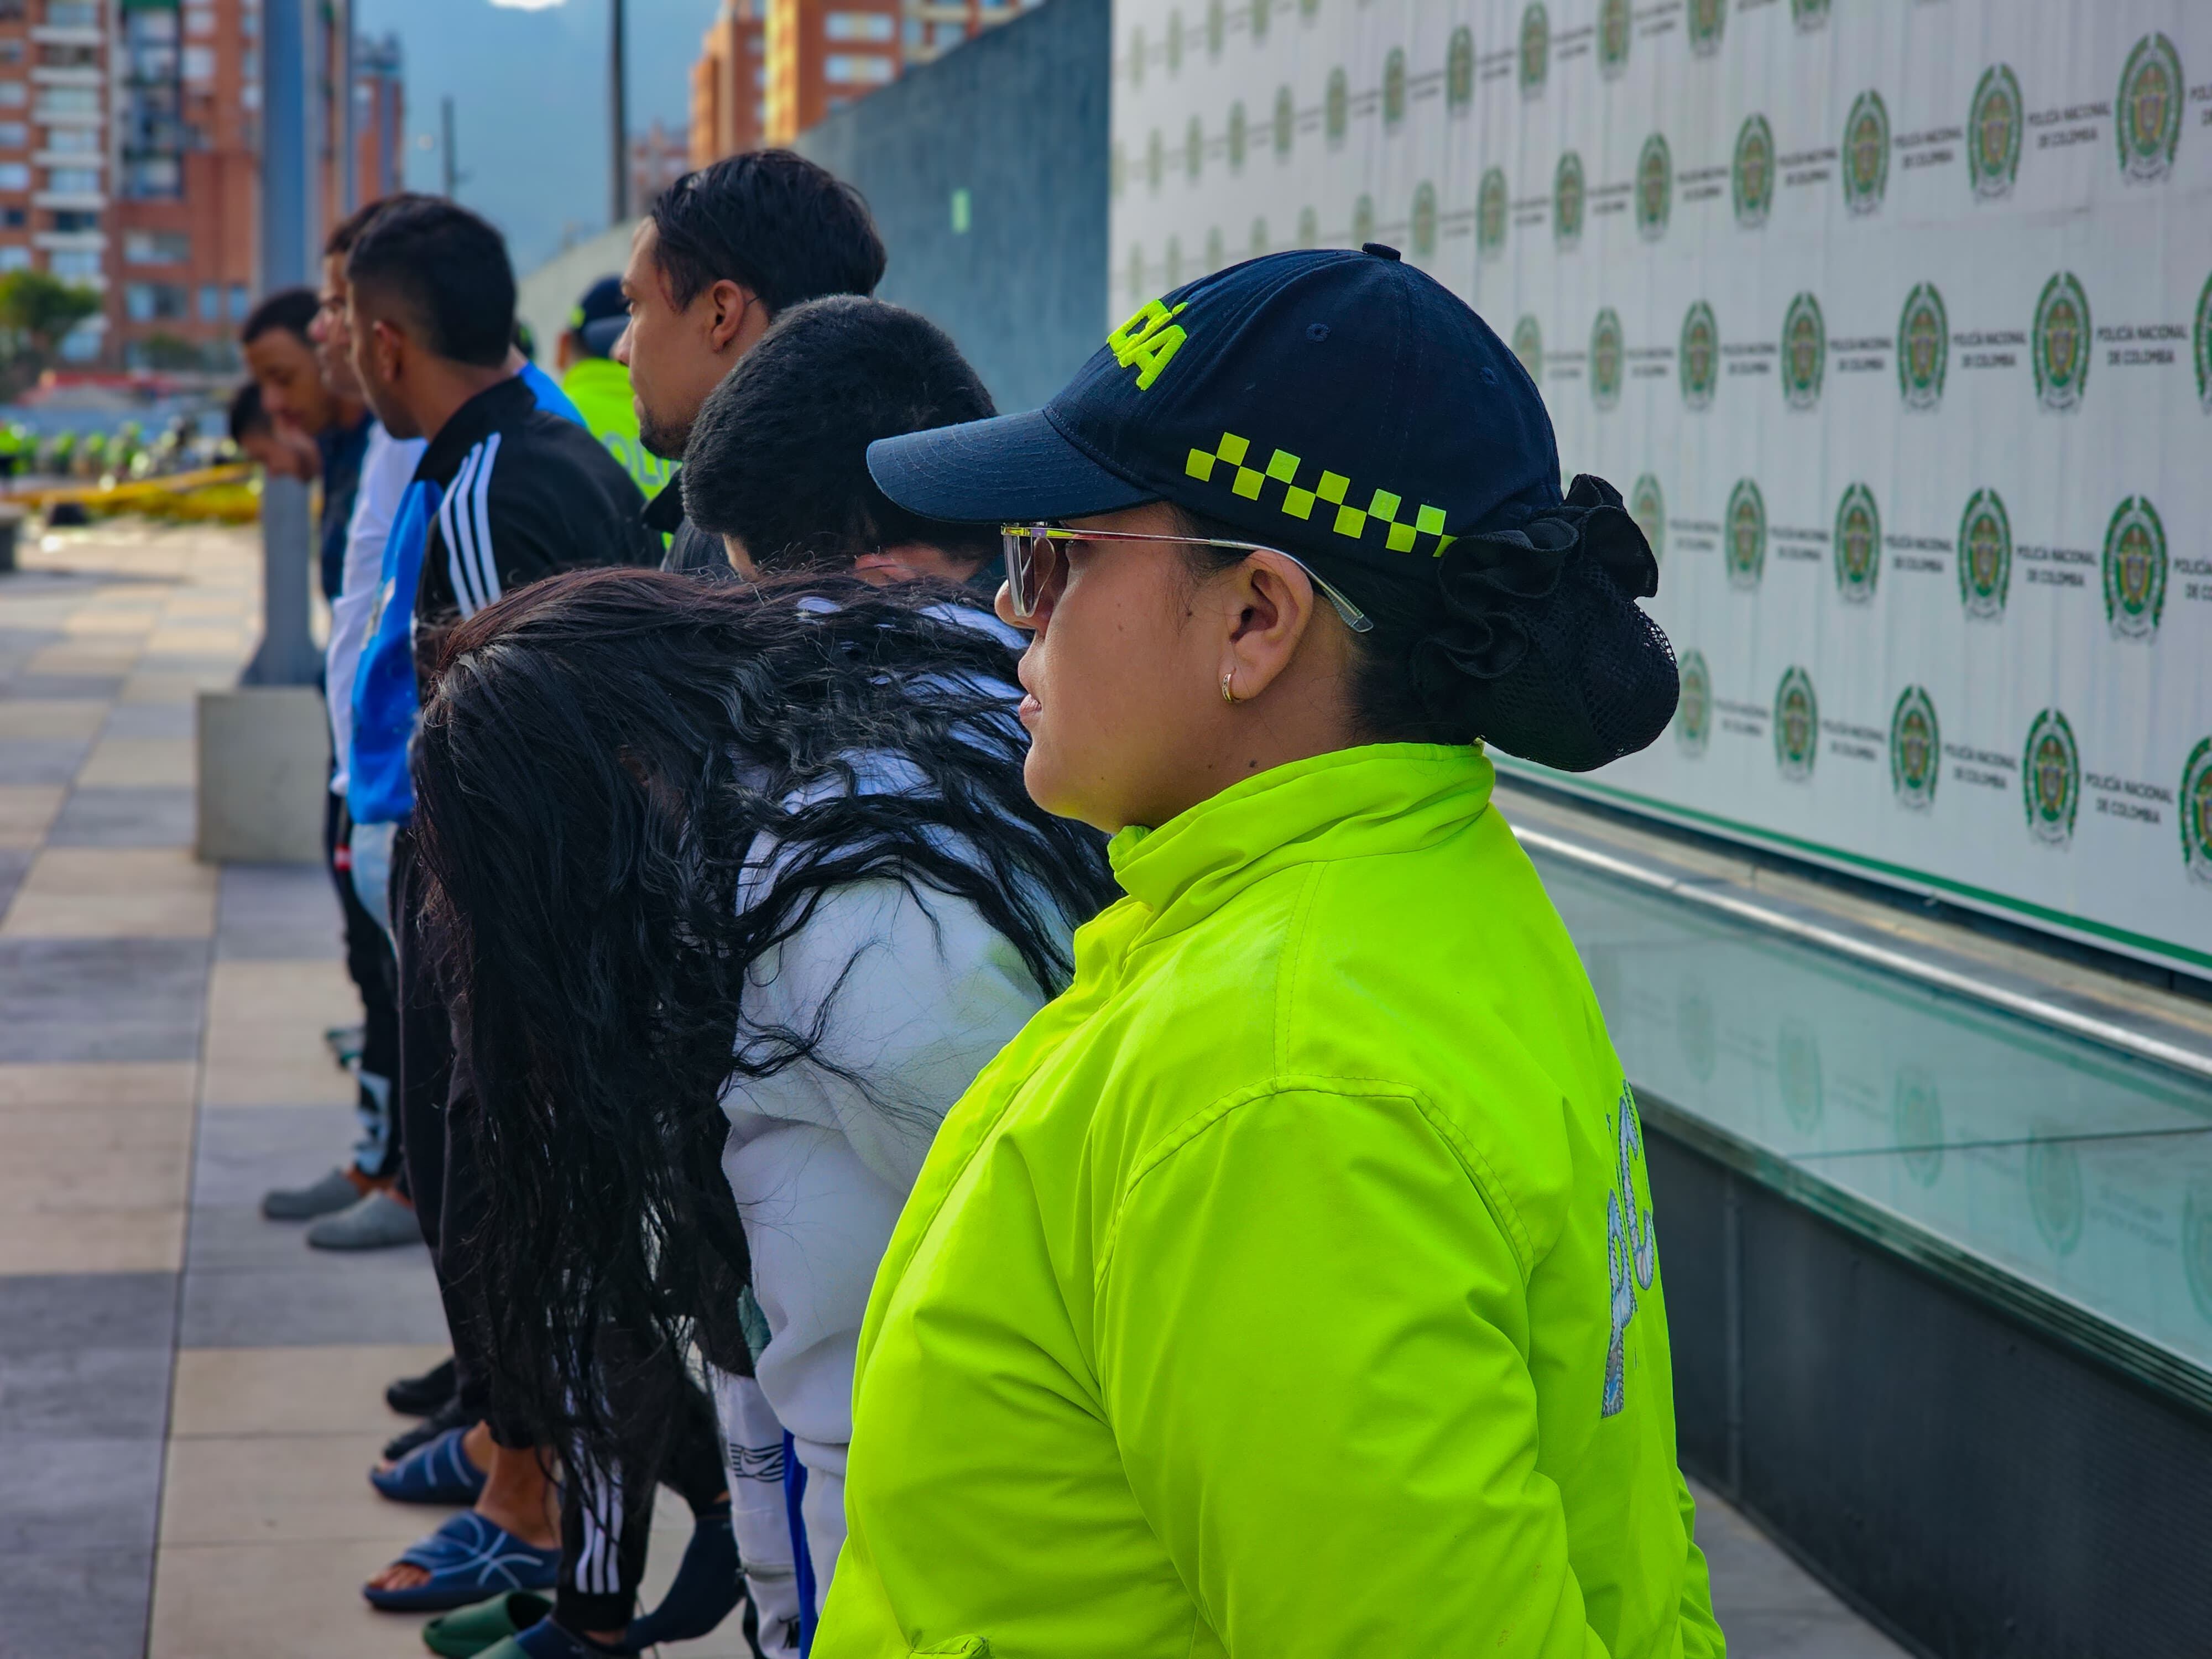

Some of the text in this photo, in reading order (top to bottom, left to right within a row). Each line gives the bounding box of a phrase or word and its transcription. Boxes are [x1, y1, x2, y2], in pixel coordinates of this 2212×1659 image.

[2124, 780, 2173, 804] NACIONAL
[2096, 797, 2161, 825] DE COLOMBIA
